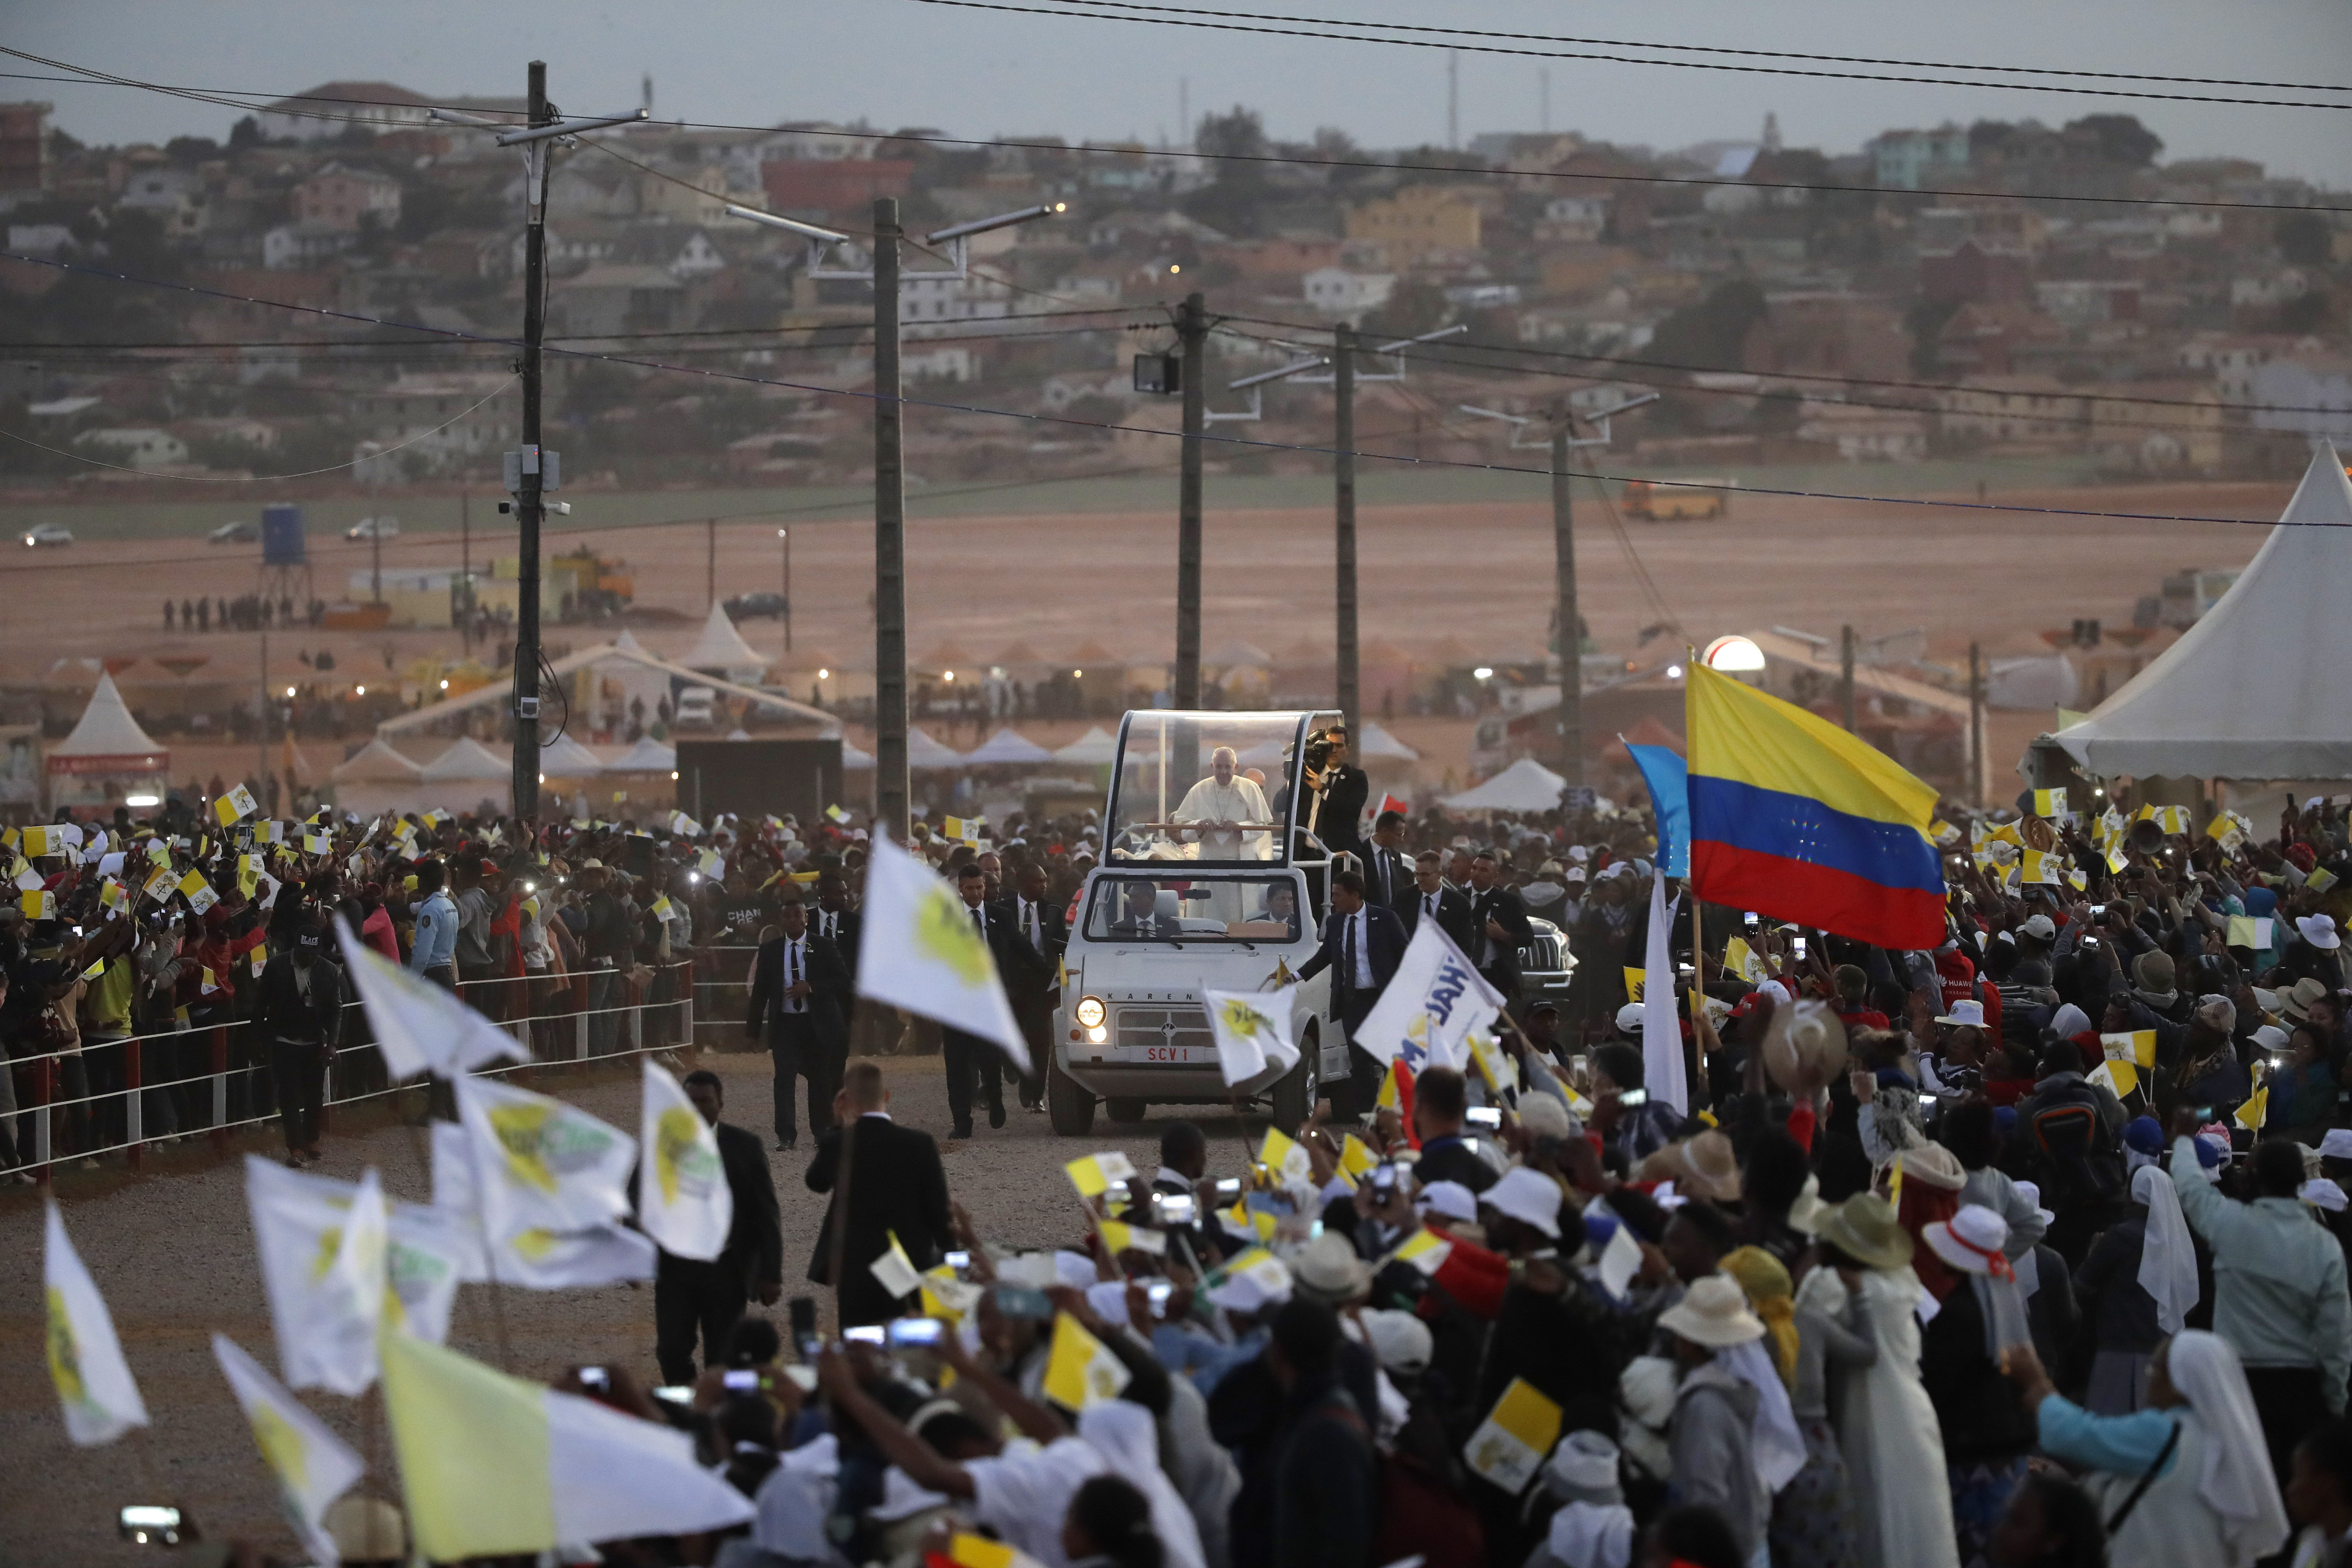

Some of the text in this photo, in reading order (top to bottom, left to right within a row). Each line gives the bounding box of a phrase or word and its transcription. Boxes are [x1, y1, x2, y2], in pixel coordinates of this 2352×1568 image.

[301, 935, 318, 944] BLACK
[1148, 1048, 1187, 1061] SCV 1
